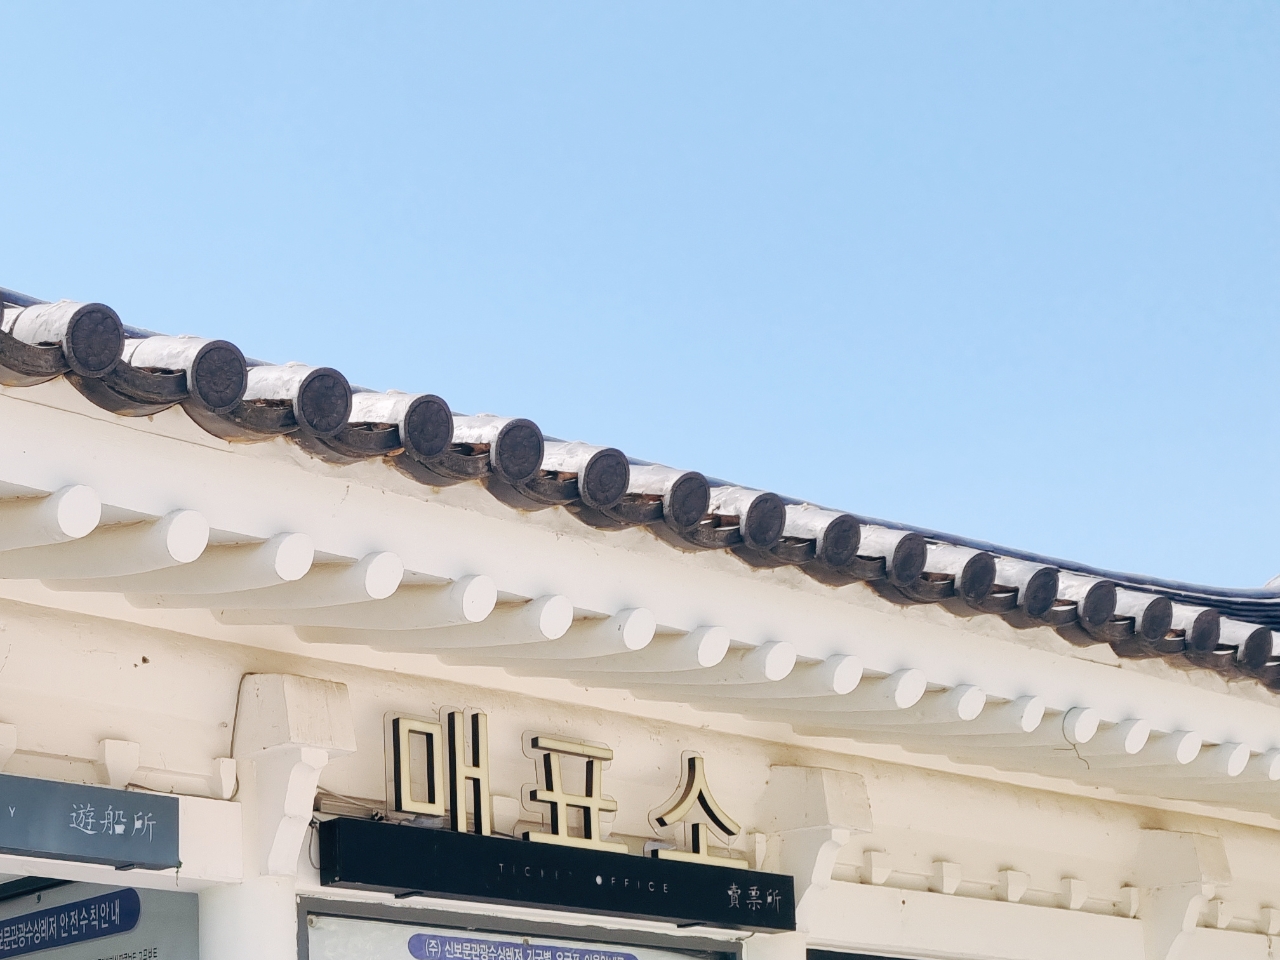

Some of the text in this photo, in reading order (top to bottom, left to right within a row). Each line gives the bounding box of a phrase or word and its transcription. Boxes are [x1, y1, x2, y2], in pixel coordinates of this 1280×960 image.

[392, 711, 749, 870] 매표소
[595, 875, 669, 893] OFFICE
[425, 939, 441, 958] (주)
